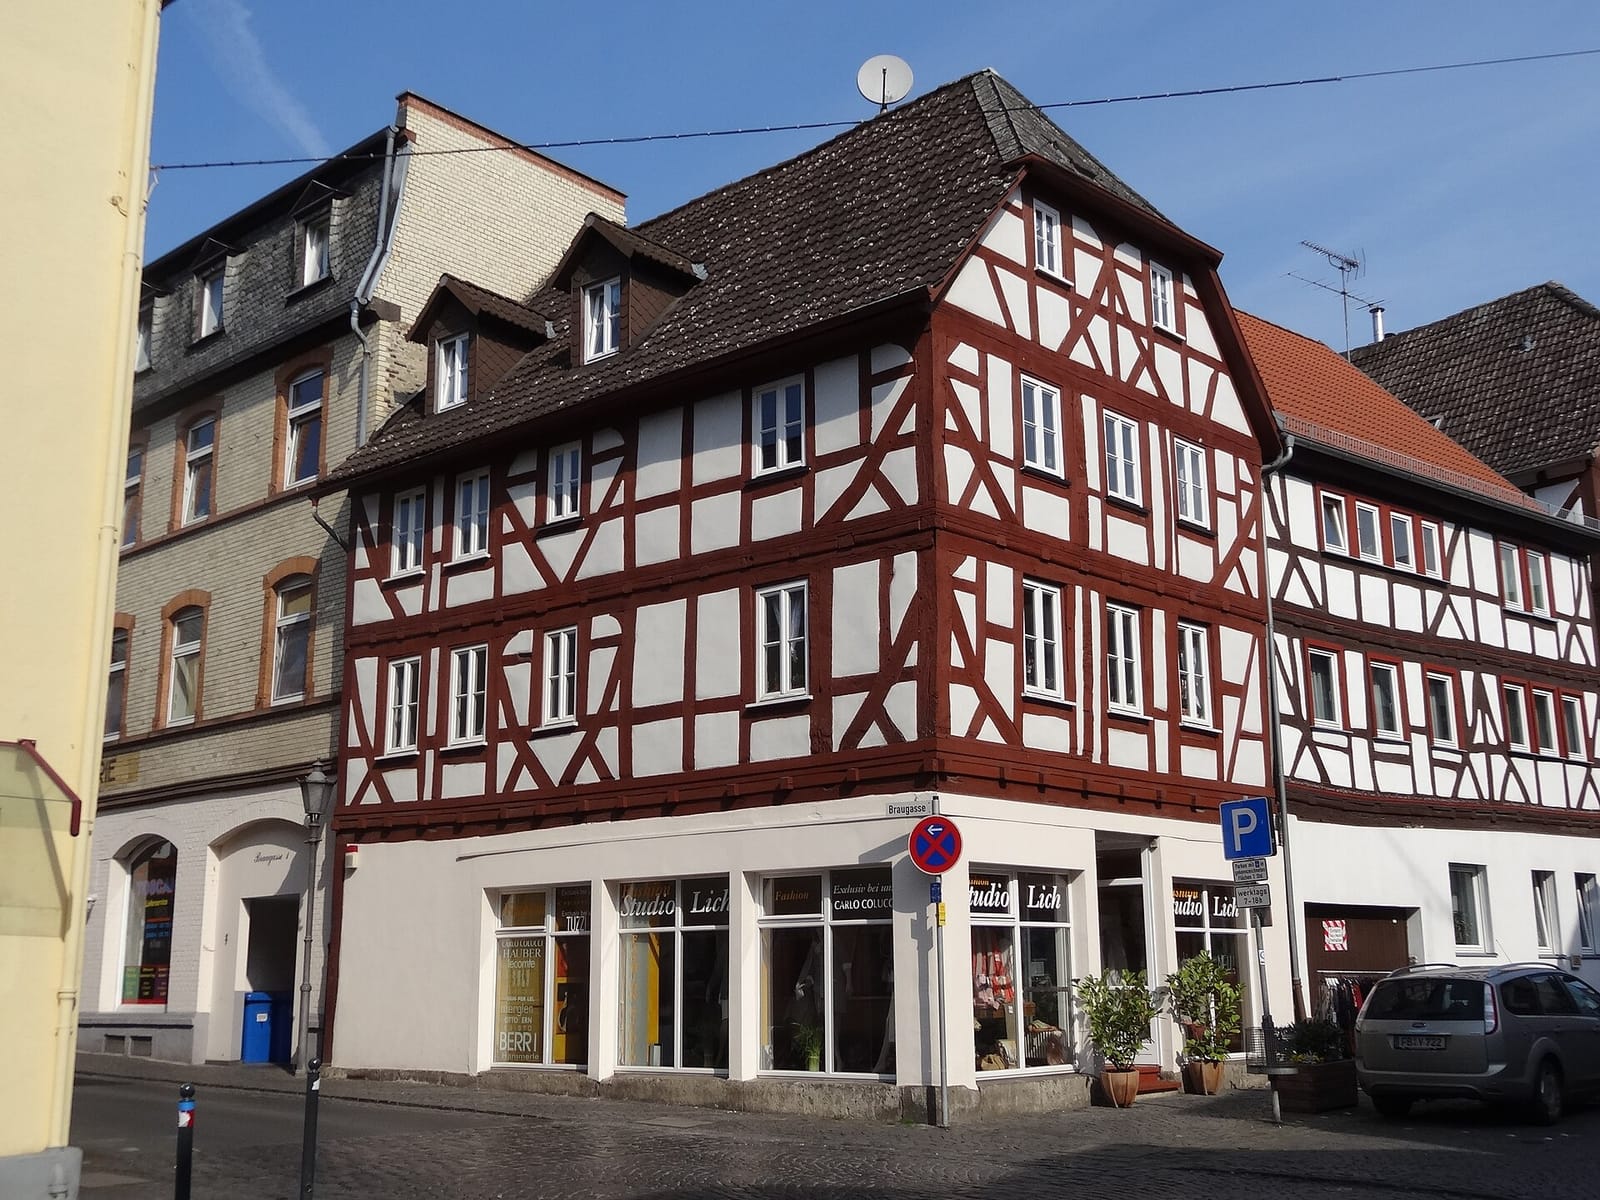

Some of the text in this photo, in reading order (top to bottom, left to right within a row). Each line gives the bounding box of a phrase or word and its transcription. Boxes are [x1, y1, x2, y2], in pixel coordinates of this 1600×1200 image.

[888, 805, 926, 815] Braugasse
[1231, 808, 1258, 852] P
[867, 883, 879, 893] bei
[969, 883, 1009, 908] tudio
[1027, 885, 1061, 909] Lich
[1238, 889, 1267, 897] werktags
[621, 893, 676, 917] Studio
[834, 898, 893, 910] CARLO COLUCC
[1174, 895, 1203, 916] udio
[1213, 896, 1239, 918] Lich
[503, 948, 542, 958] HAUBER
